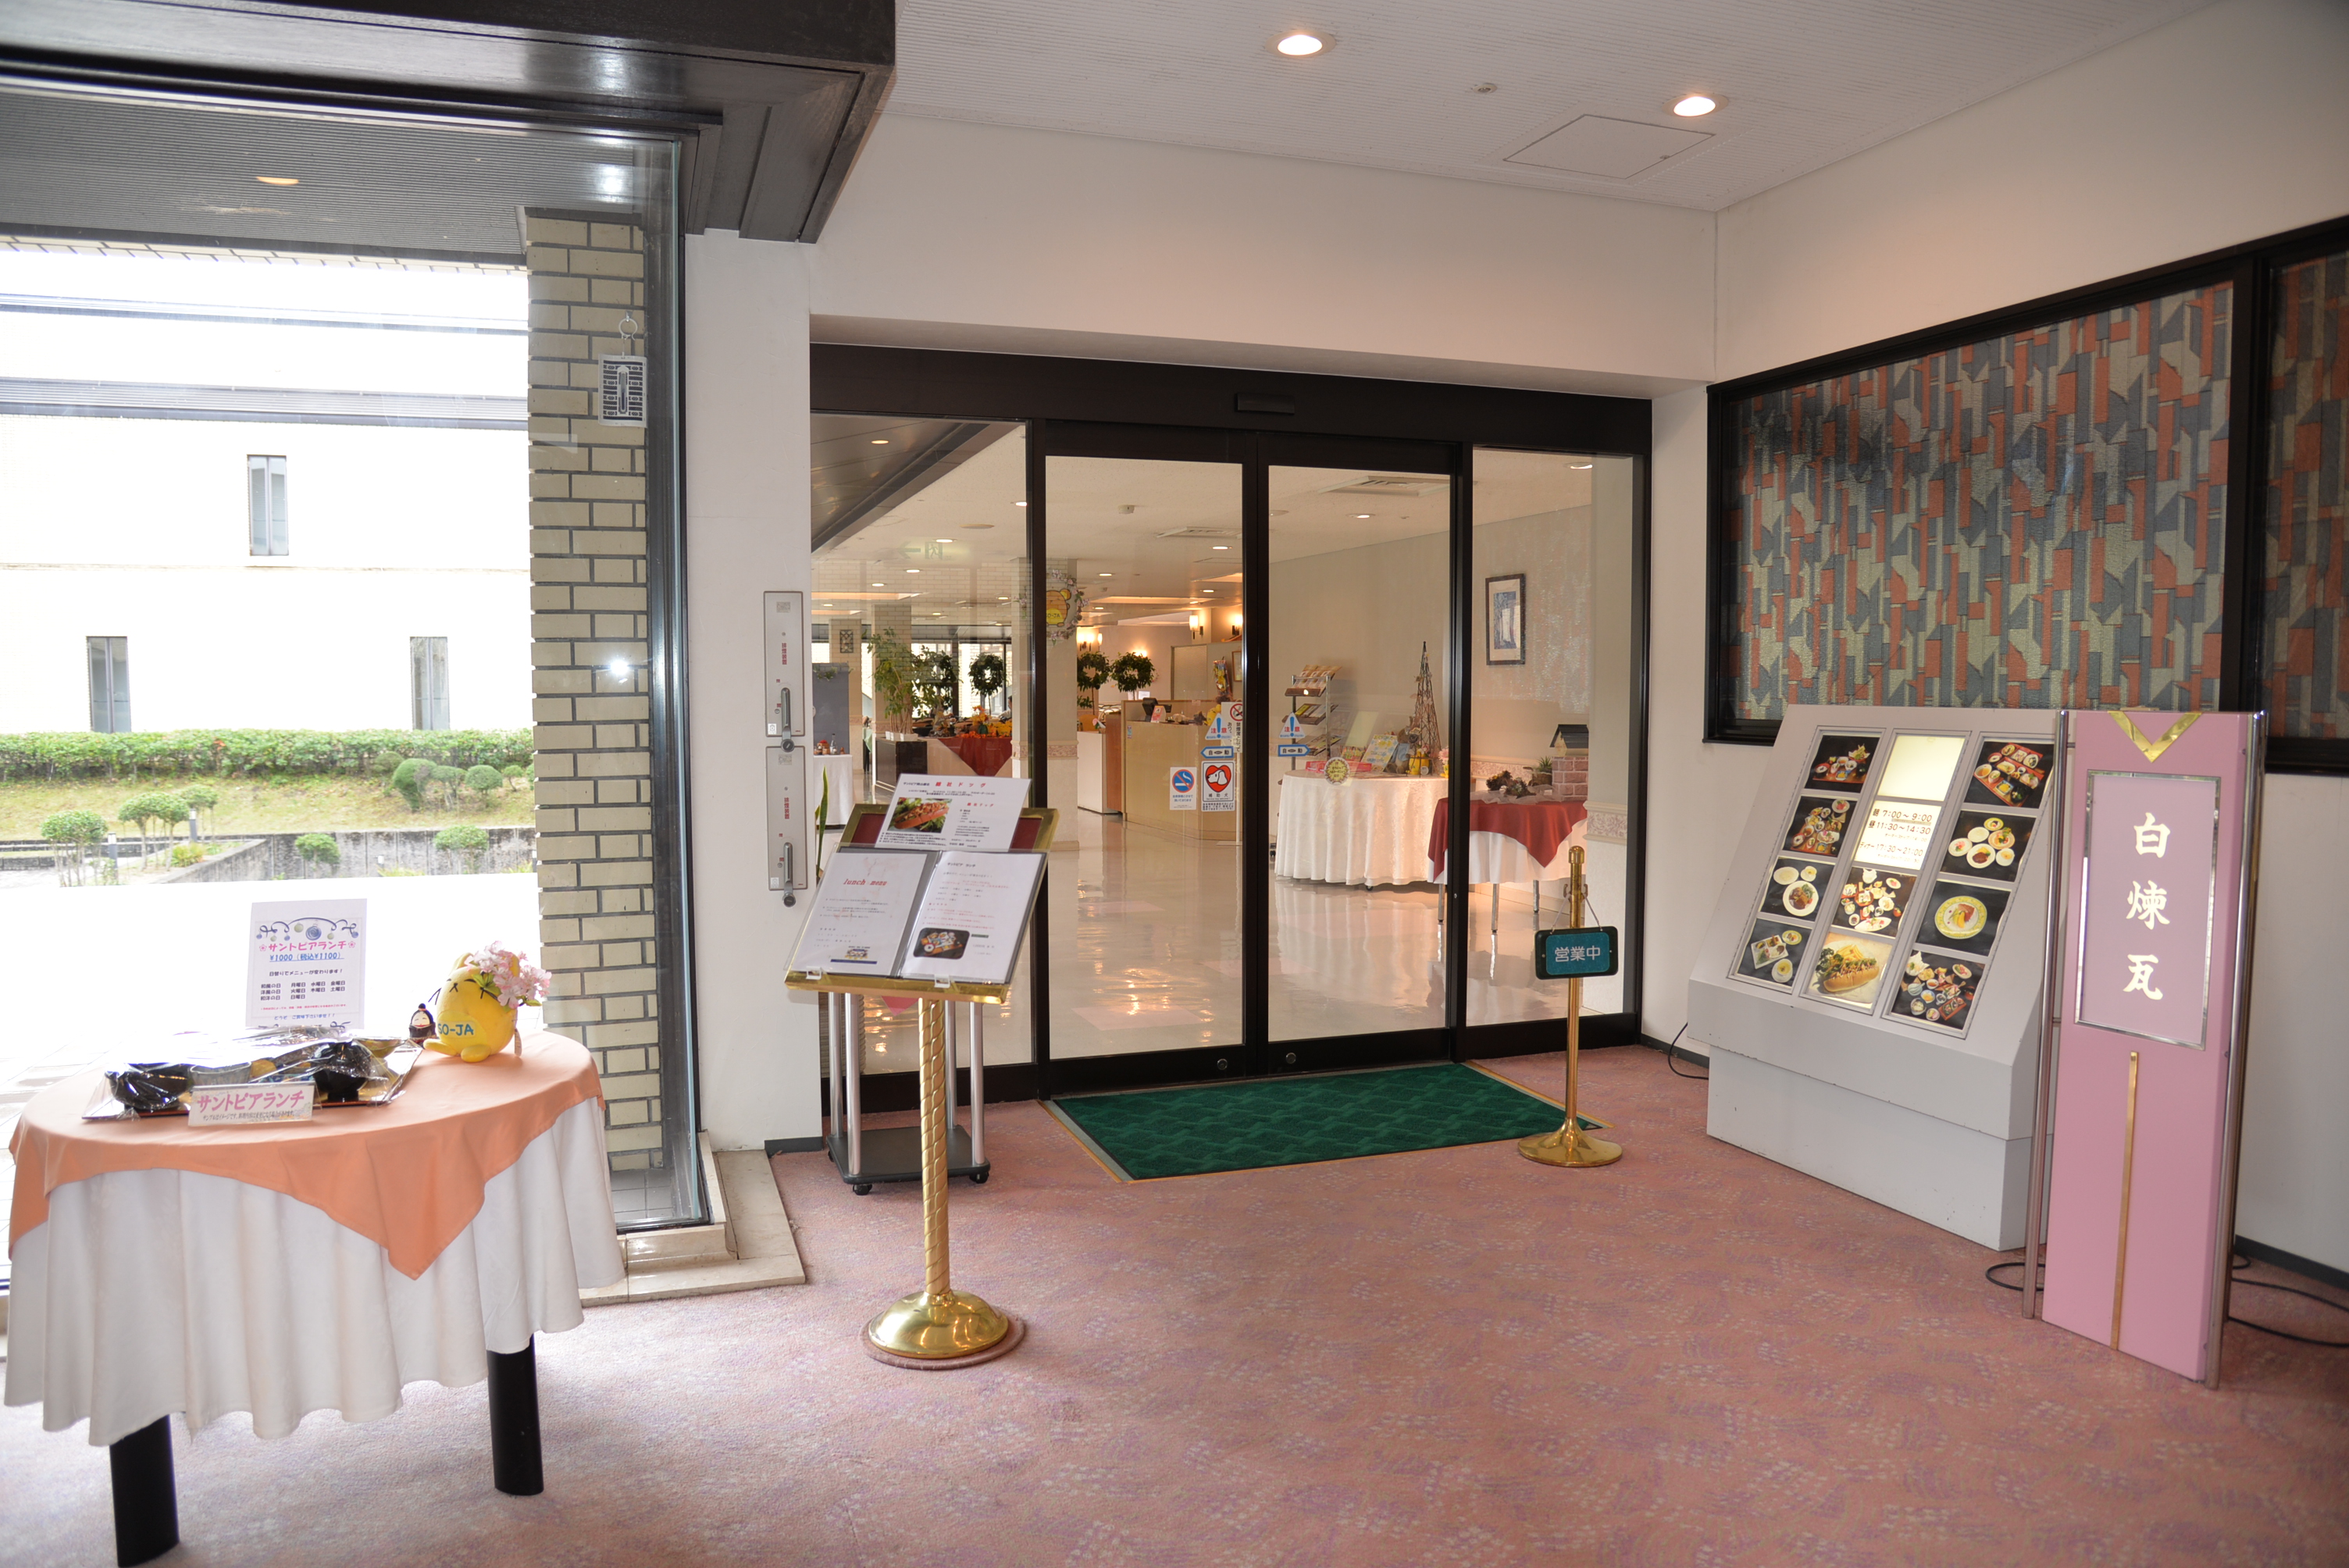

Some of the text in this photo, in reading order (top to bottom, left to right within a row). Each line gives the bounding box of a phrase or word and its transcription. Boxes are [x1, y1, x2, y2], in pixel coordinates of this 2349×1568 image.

[2123, 812, 2171, 1001] 白煉瓦
[269, 940, 347, 952] サントピアランチ
[1554, 945, 1601, 962] 営業中
[437, 1023, 474, 1036] SO-JA
[197, 1089, 305, 1113] サントピアランチ
